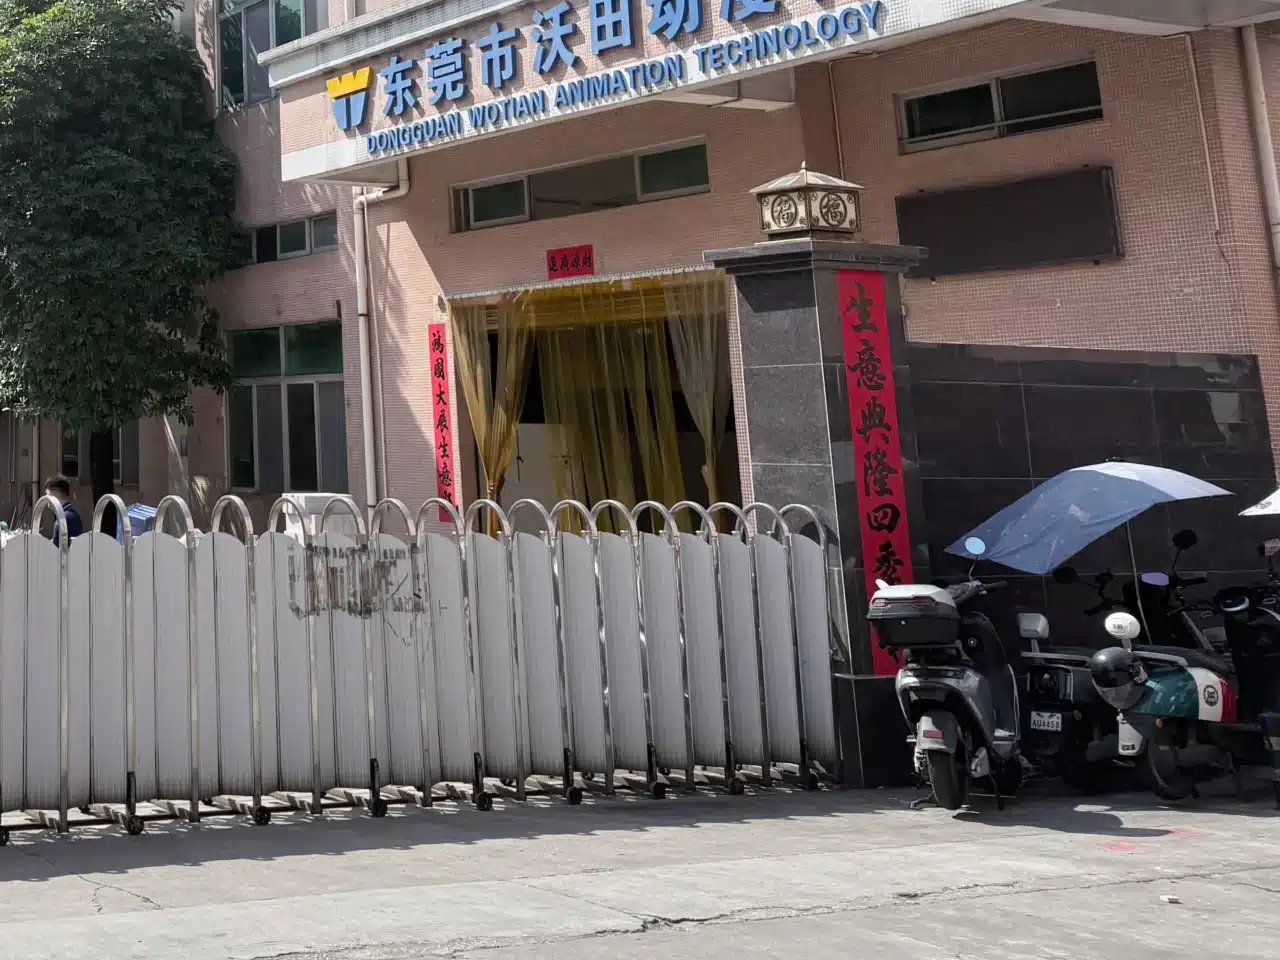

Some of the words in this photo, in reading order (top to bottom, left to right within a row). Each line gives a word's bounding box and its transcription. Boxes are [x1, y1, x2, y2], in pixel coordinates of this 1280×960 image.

[365, 110, 461, 153] DONGGUAN
[468, 89, 545, 129] WOTIAN
[554, 54, 684, 108] ANIMATION
[694, 0, 882, 73] TECHNOLOGY
